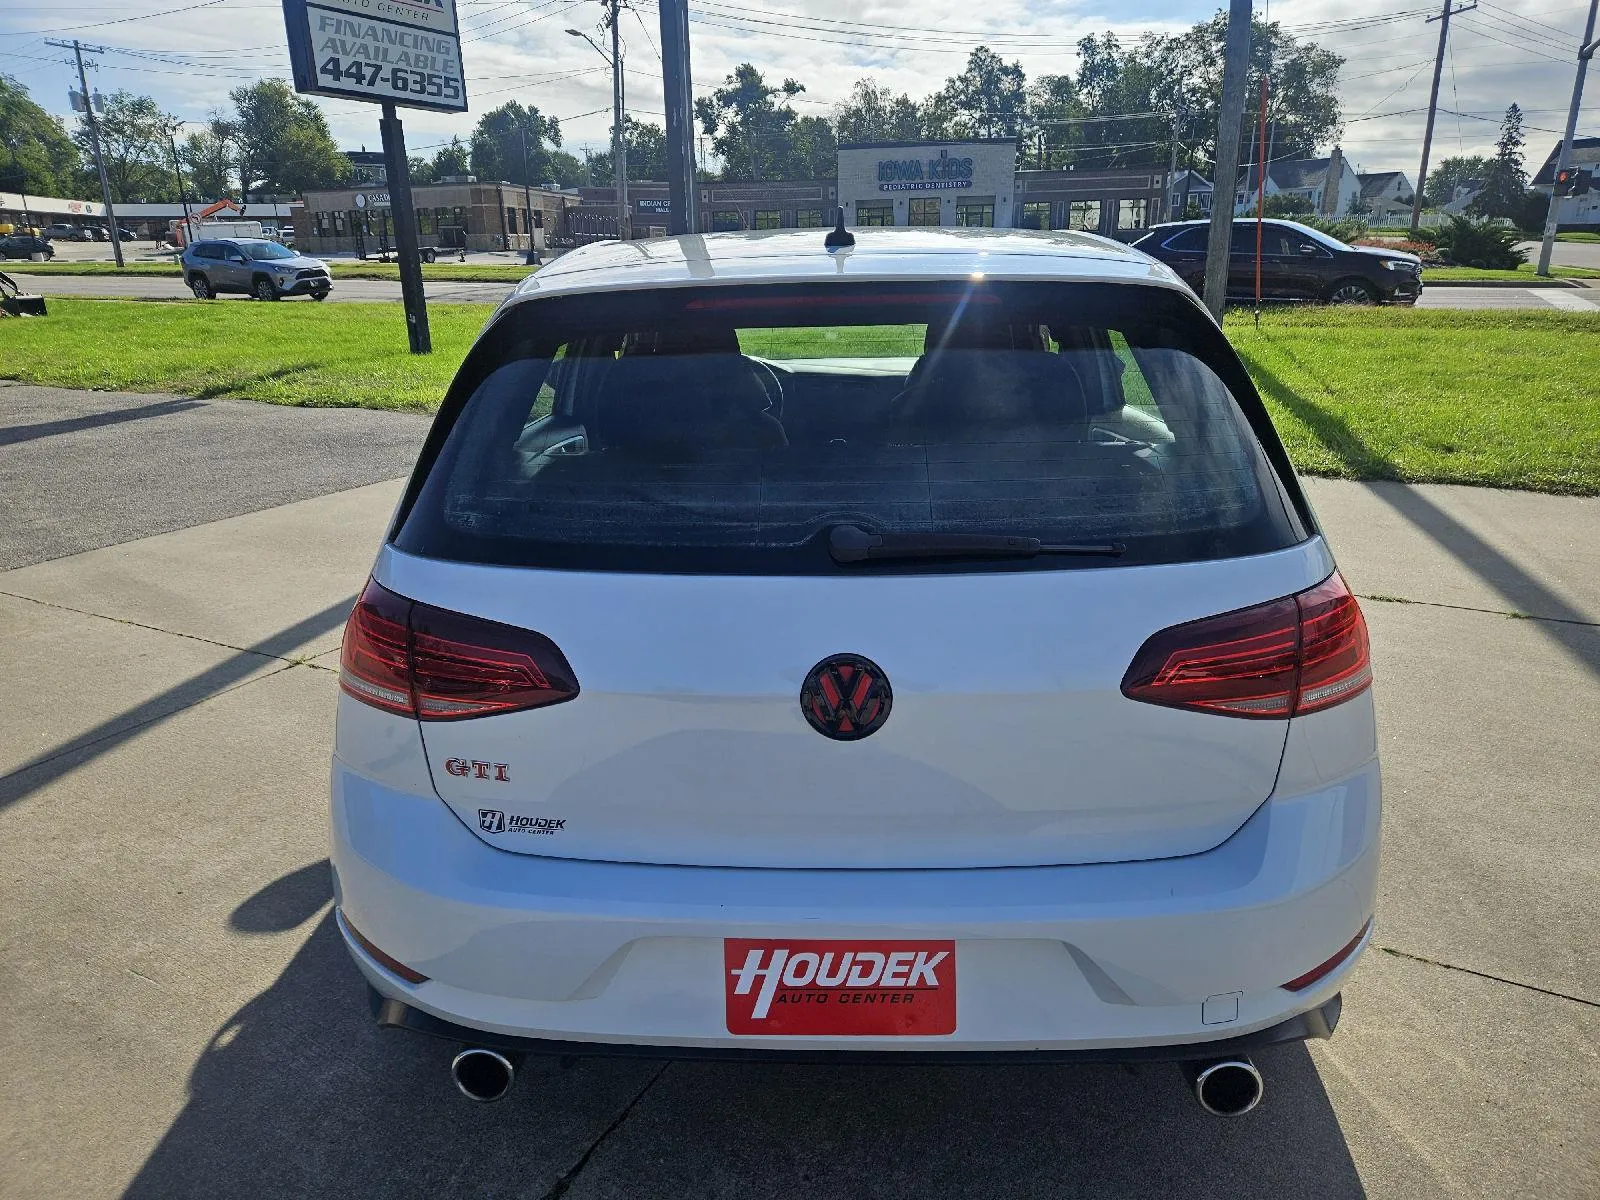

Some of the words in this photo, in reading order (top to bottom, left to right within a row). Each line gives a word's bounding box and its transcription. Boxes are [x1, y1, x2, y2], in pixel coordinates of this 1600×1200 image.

[377, 3, 429, 21] CENTER
[318, 15, 451, 55] FINANCING
[320, 36, 455, 74] AVAILABLE
[320, 56, 460, 100] 447-6355
[878, 159, 923, 181] IOWA
[883, 182, 923, 191] PEDIATRIC
[925, 181, 967, 189] DENTISTRY
[446, 757, 510, 782] GTI
[508, 815, 567, 829] HOUDEK
[731, 949, 950, 1019] HOUDEK
[776, 993, 829, 1004] AUTO
[838, 993, 915, 1004] CENTER
